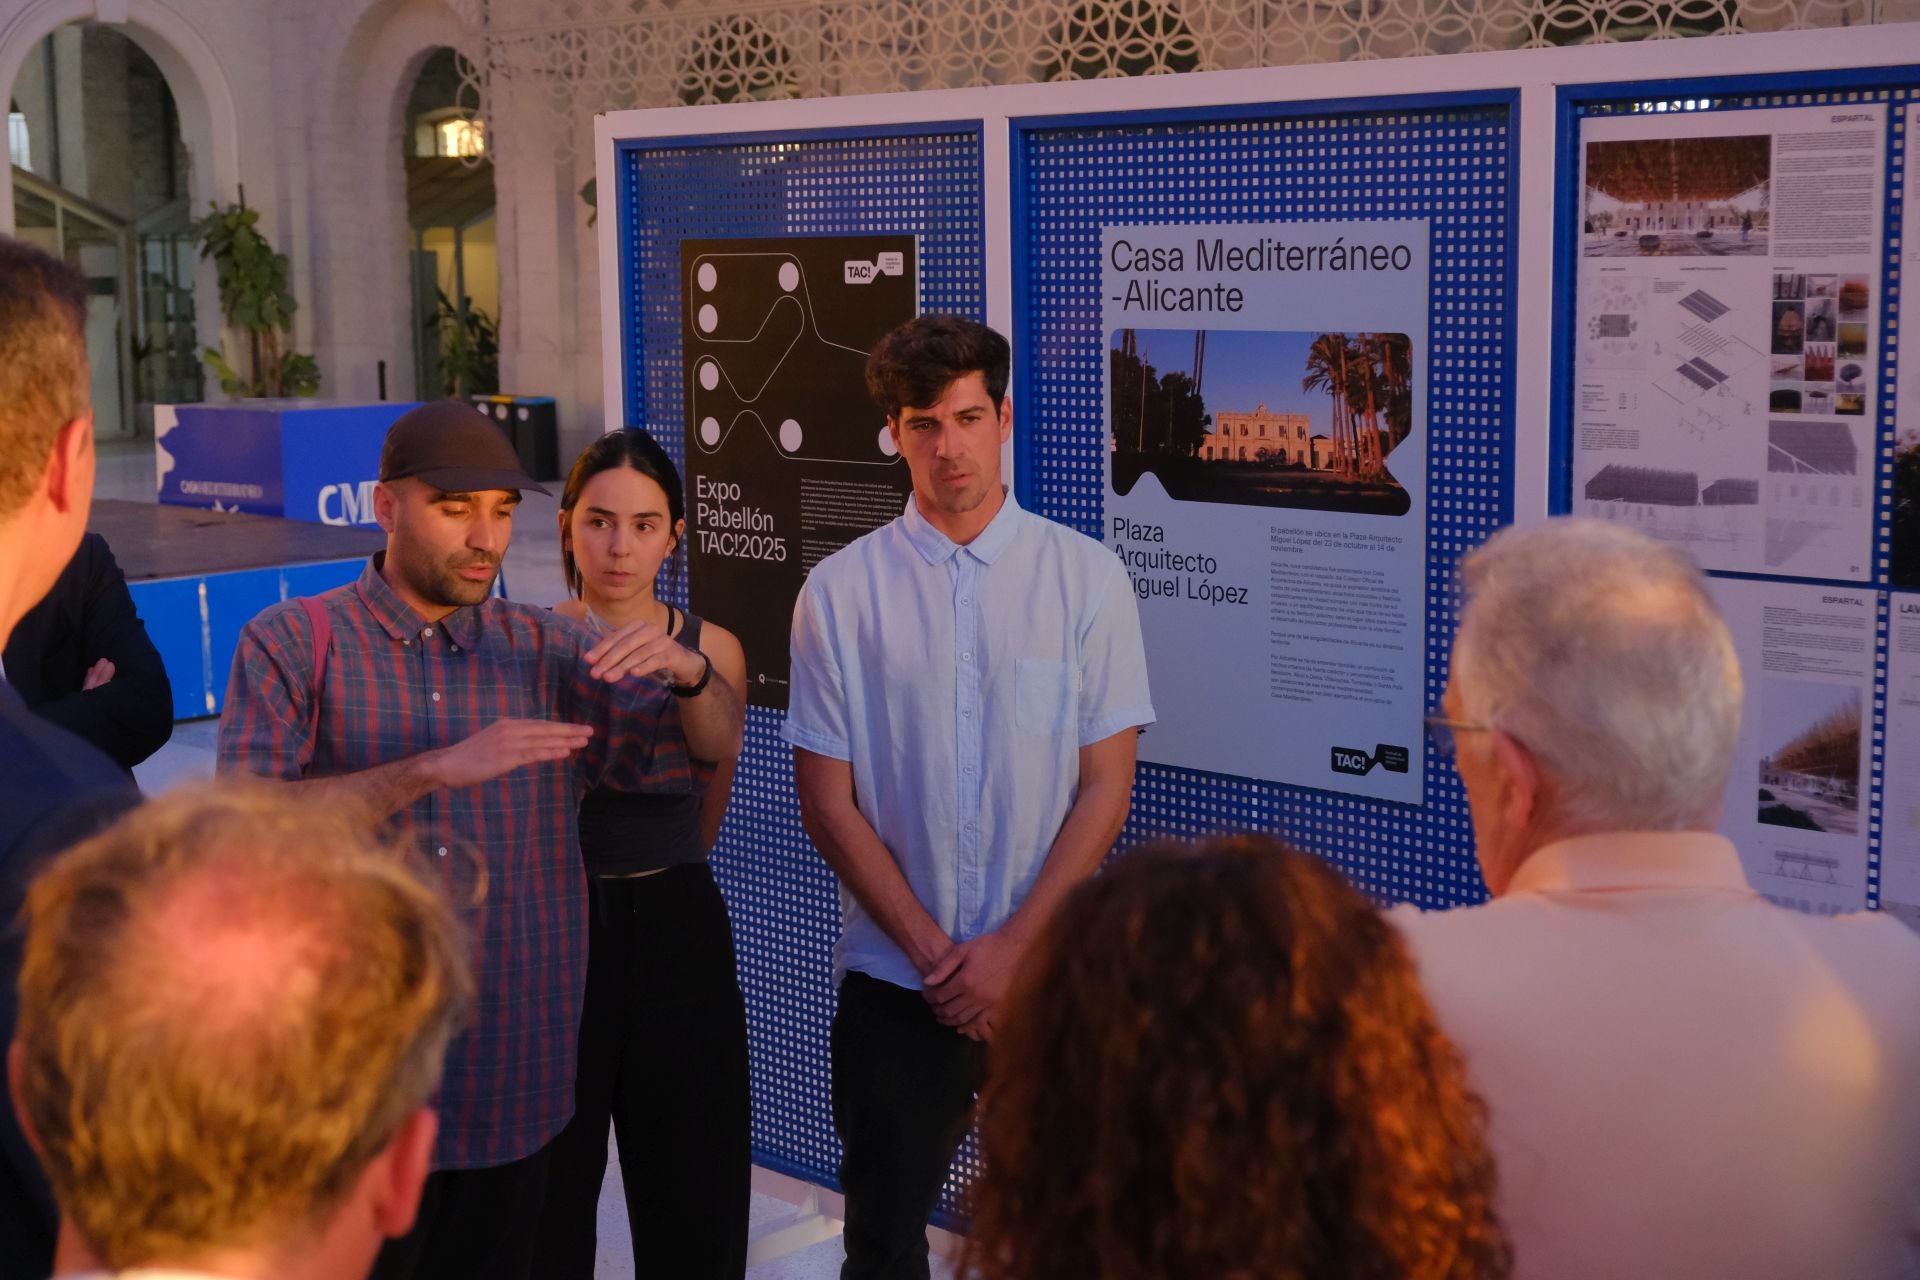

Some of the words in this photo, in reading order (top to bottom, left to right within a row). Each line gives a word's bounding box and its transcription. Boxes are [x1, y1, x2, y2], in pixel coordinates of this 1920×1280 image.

[1831, 114, 1875, 123] ESPARTAL
[1111, 239, 1184, 272] Casa
[1196, 237, 1412, 272] Mediterráneo
[847, 266, 871, 278] TAC!
[1112, 279, 1244, 312] -Alicante
[696, 475, 740, 504] Expo
[697, 502, 773, 532] Pabellón
[1113, 517, 1163, 542] Plaza
[1270, 535, 1292, 544] Miguel
[1293, 536, 1311, 546] López
[1333, 540, 1342, 548] de
[1343, 541, 1368, 550] octubre
[1386, 544, 1395, 552] de
[1314, 529, 1332, 538] ubica
[1350, 532, 1367, 541] Plaza
[1368, 534, 1403, 543] Arquitecto
[1114, 543, 1216, 574] Arquitecto
[1127, 571, 1179, 599] iguel
[1187, 577, 1248, 606] López
[1822, 596, 1864, 606] ESPARTAL
[1334, 752, 1366, 770] TAC!
